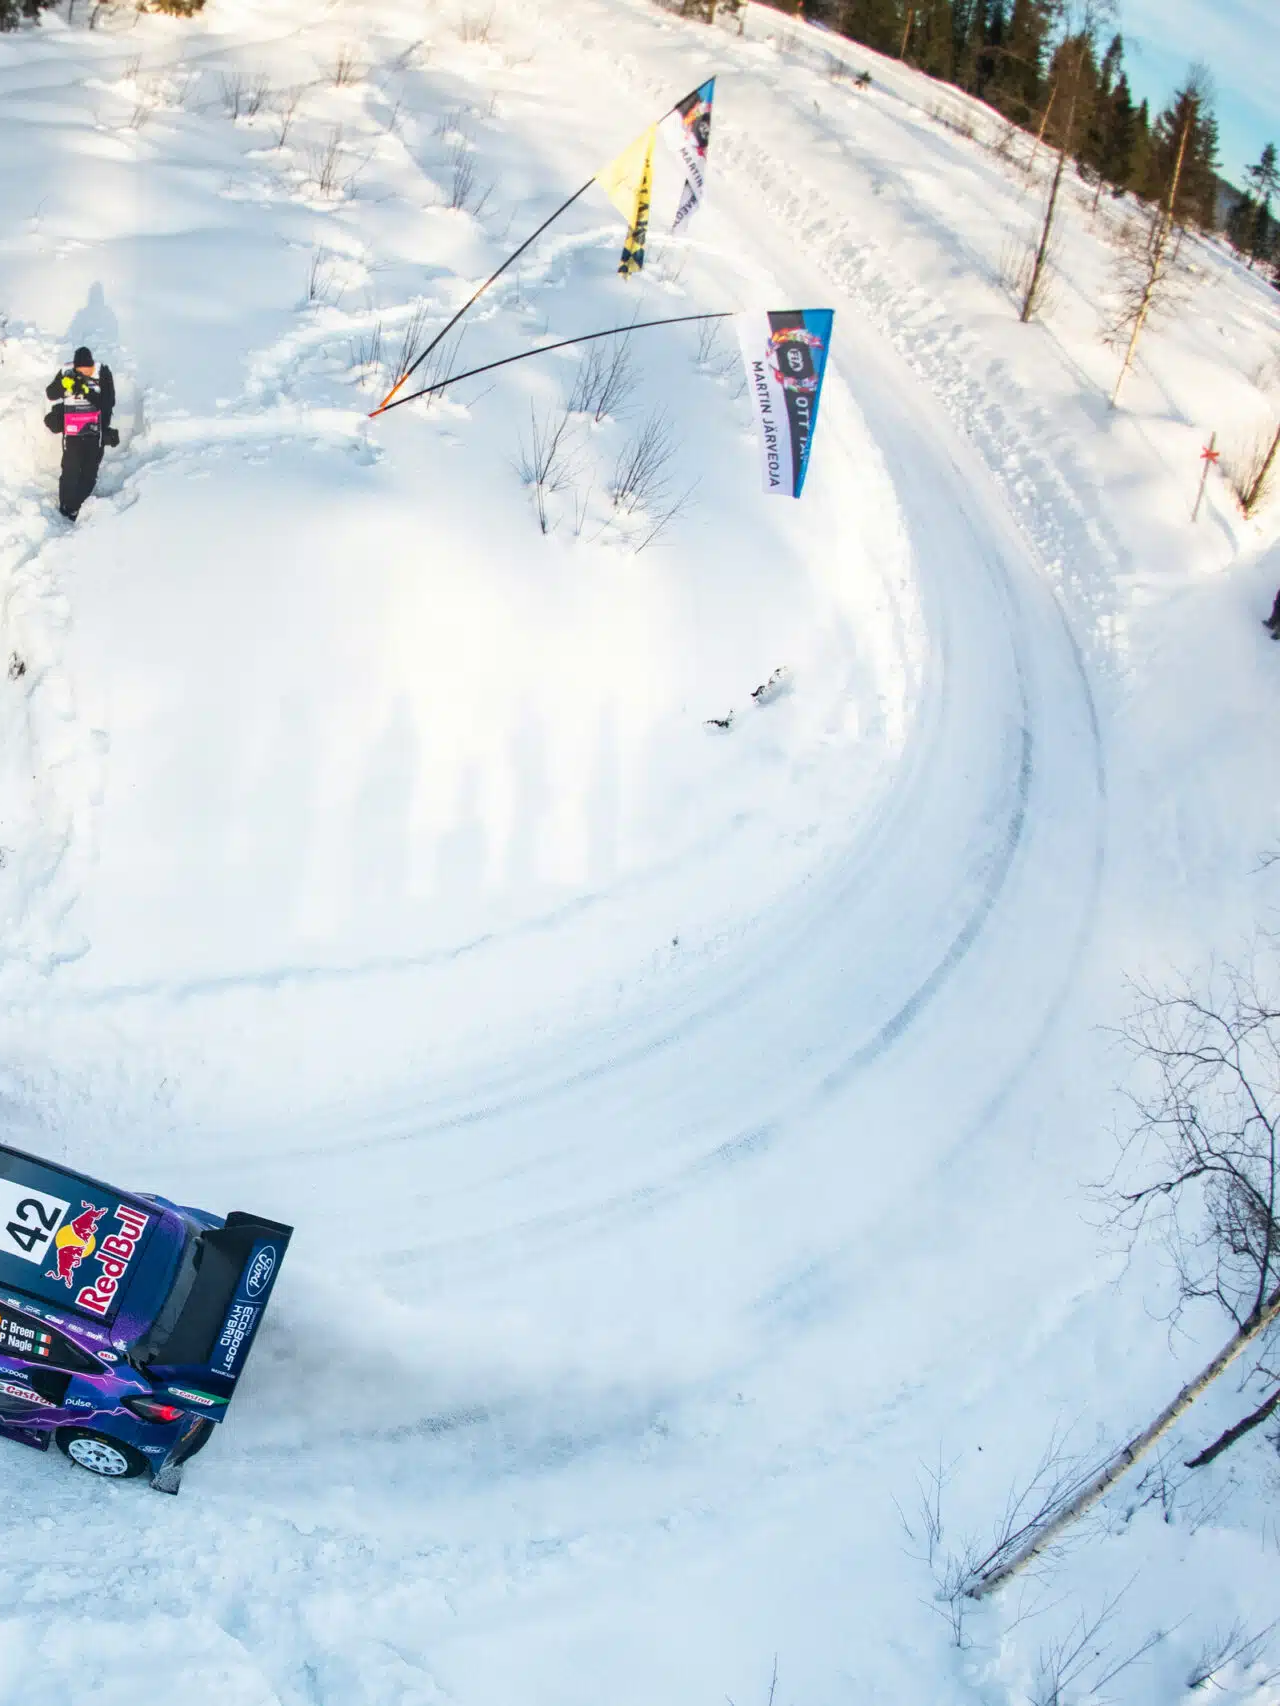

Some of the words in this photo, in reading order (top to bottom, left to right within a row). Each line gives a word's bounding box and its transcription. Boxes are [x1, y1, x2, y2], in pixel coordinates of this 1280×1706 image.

[680, 147, 704, 188] MARTIN
[788, 349, 804, 370] FIA
[752, 360, 773, 414] MARTIN
[794, 396, 810, 430] OTT
[762, 417, 781, 488] JÄRVEOJA
[5, 1198, 63, 1253] 42
[248, 1253, 273, 1289] Ford
[0, 1319, 9, 1331] C
[9, 1321, 35, 1339] Breen
[7, 1334, 33, 1352] Nagle
[219, 1304, 245, 1347] HYBRID
[223, 1306, 255, 1371] ECOBOOST
[100, 1351, 115, 1360] BELL
[65, 1398, 92, 1408] pulse
[179, 1391, 212, 1405] Castrol
